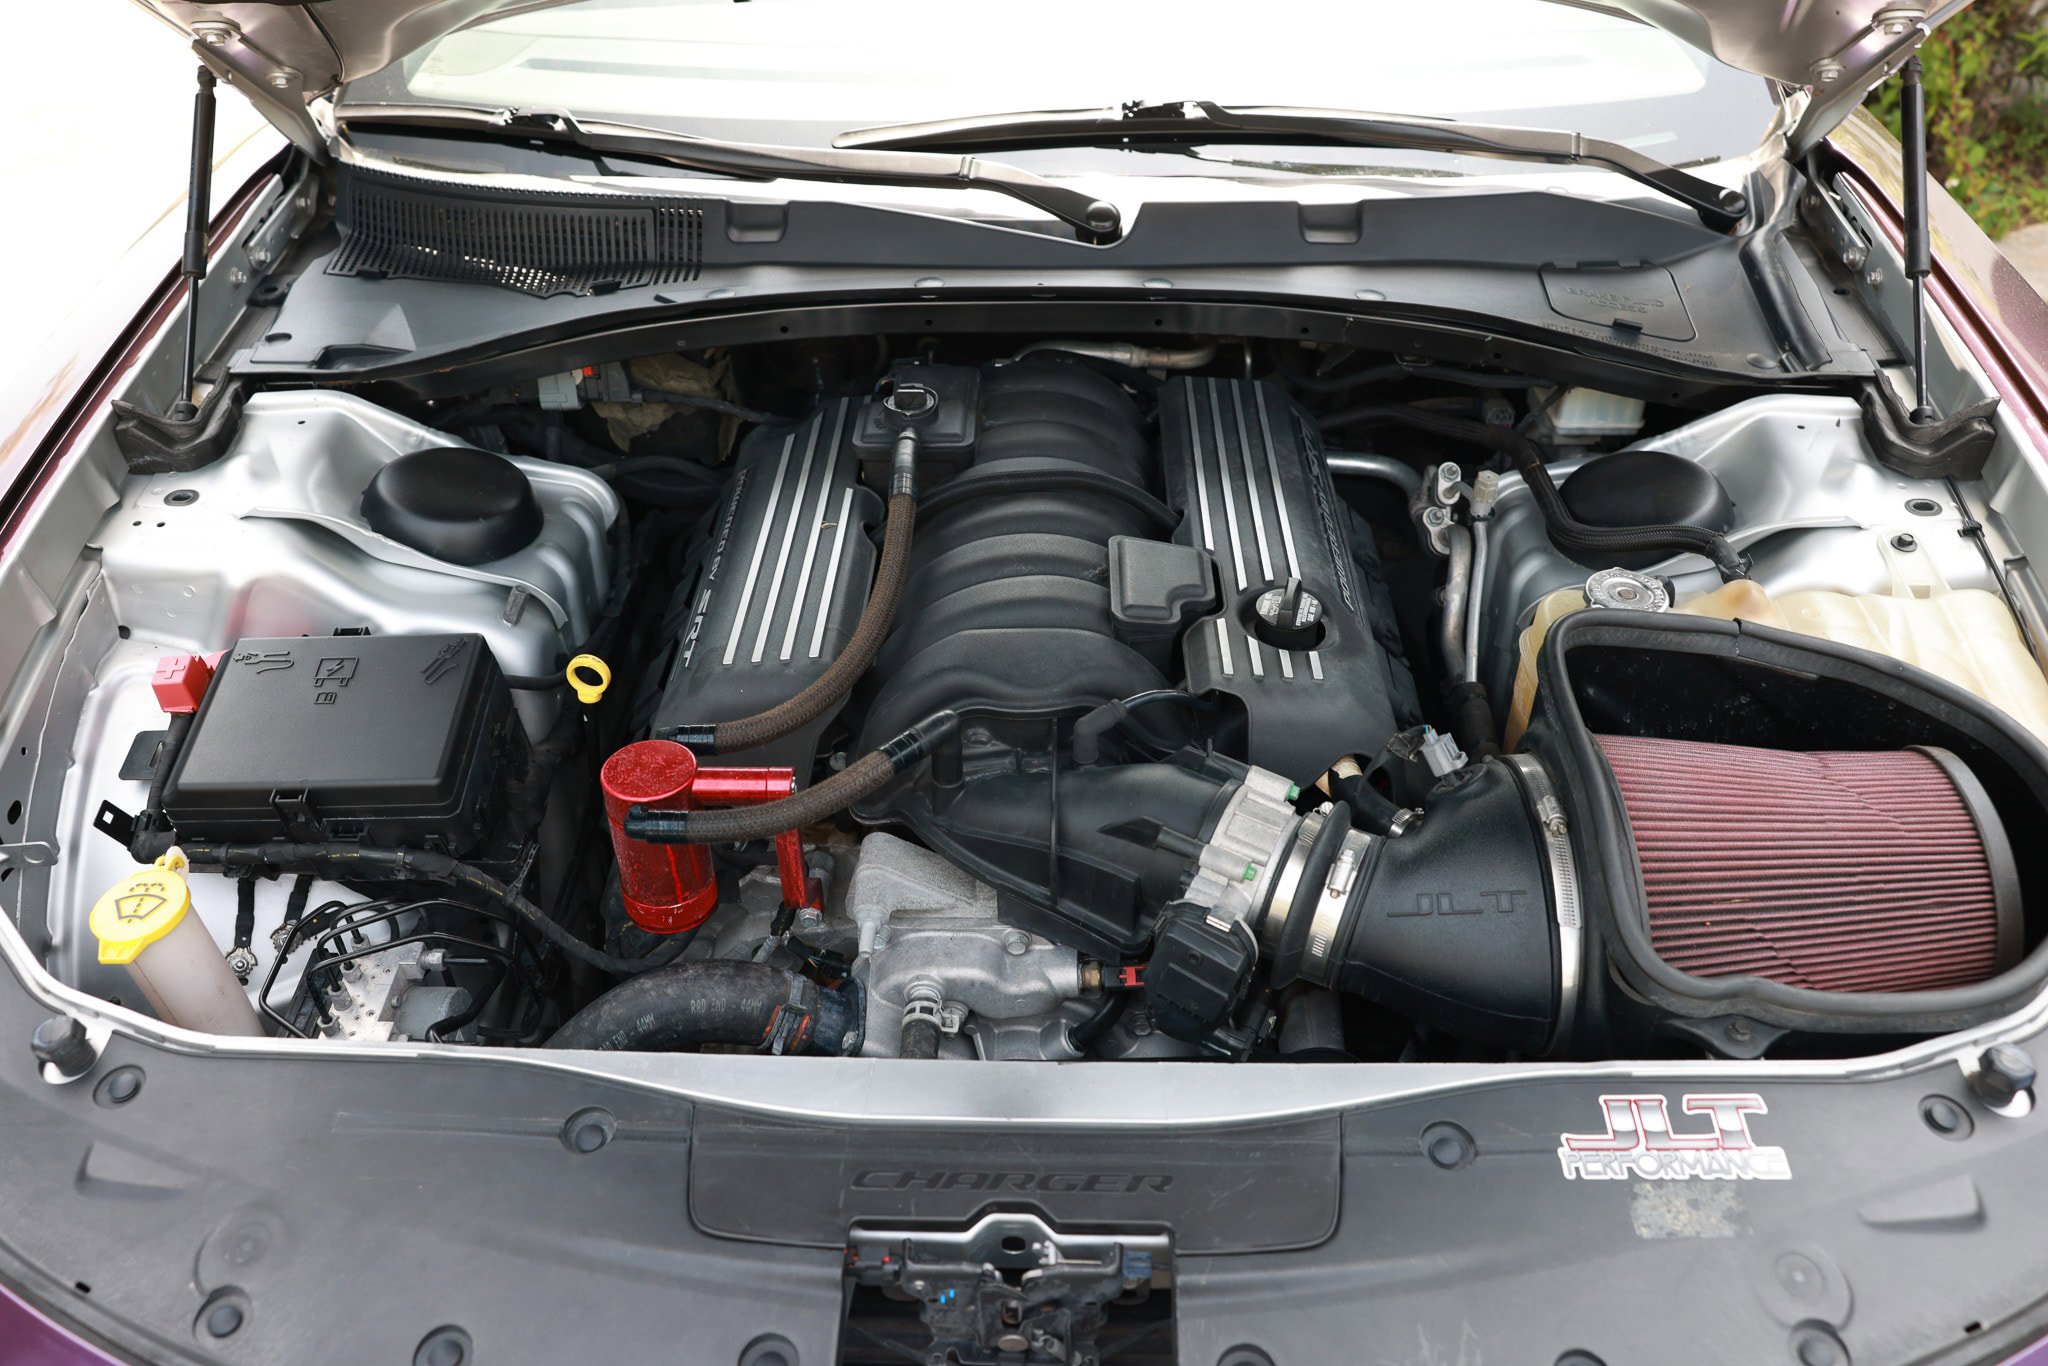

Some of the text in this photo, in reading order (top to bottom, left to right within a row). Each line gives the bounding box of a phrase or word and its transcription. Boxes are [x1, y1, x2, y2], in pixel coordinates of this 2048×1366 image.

[1566, 287, 1618, 301] BRAKE
[1587, 299, 1647, 314] ACCESS
[709, 555, 721, 580] BY
[1323, 511, 1355, 612] POWERED
[683, 588, 712, 668] SRT
[1387, 890, 1527, 917] JLT
[690, 998, 706, 1014] RAD
[612, 1030, 629, 1050] END
[1565, 1098, 1763, 1150] JLT
[1562, 1149, 1790, 1176] PERFORMANCE
[850, 1169, 1174, 1194] CHARGER
